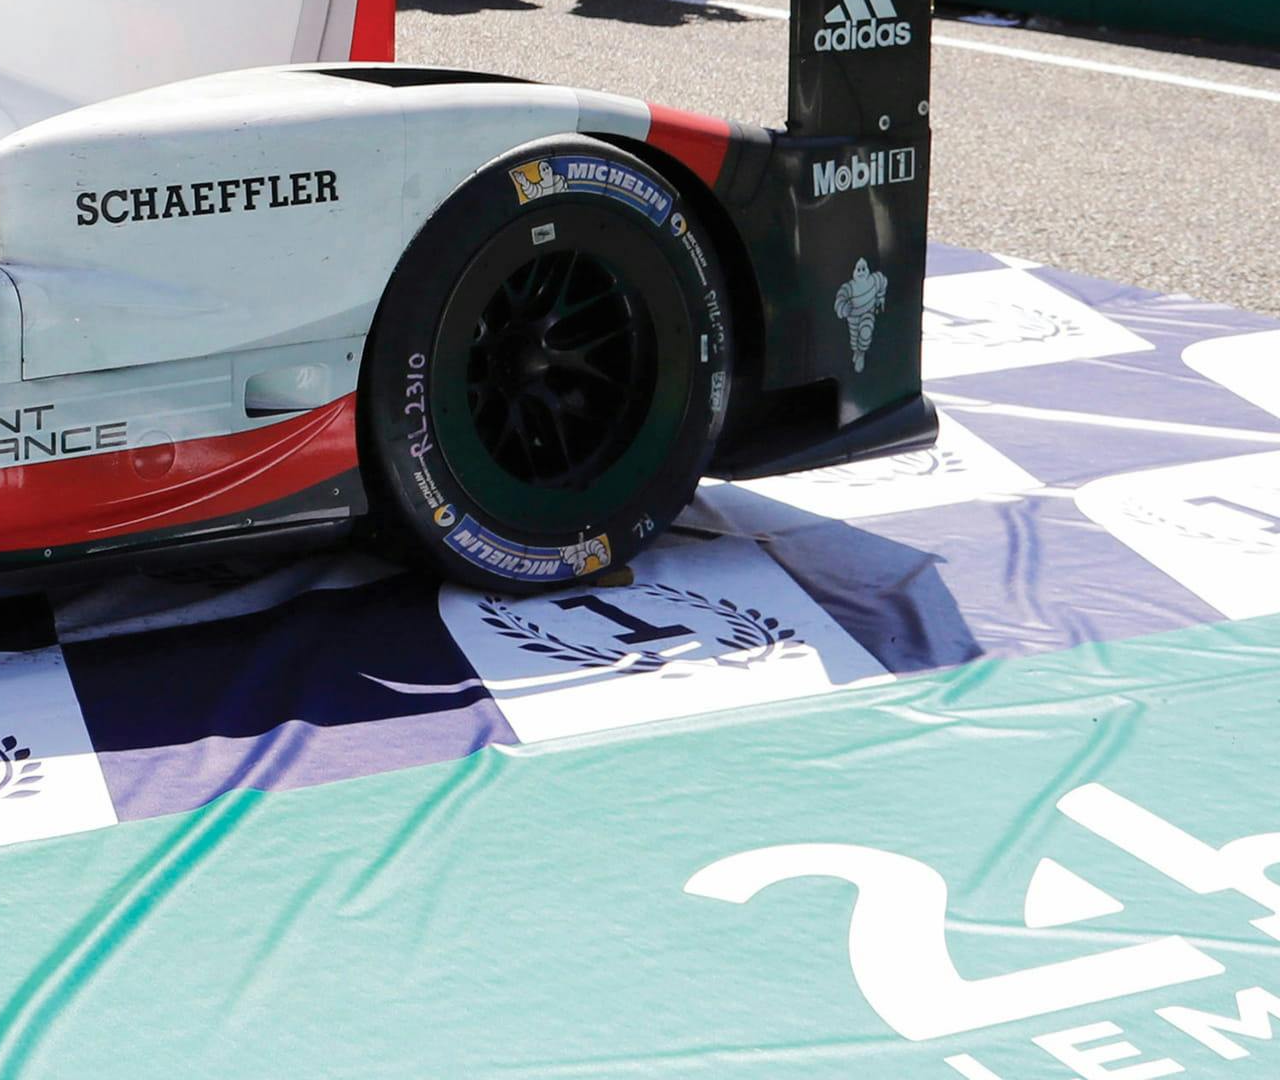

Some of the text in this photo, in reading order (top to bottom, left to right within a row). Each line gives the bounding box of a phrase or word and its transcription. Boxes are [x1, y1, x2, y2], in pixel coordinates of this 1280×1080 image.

[813, 17, 912, 52] adidas
[568, 162, 669, 211] MICHELIN
[813, 149, 912, 197] Mobil 1
[76, 170, 339, 227] SCHAEFFLER
[452, 528, 560, 577] MICHELIN
